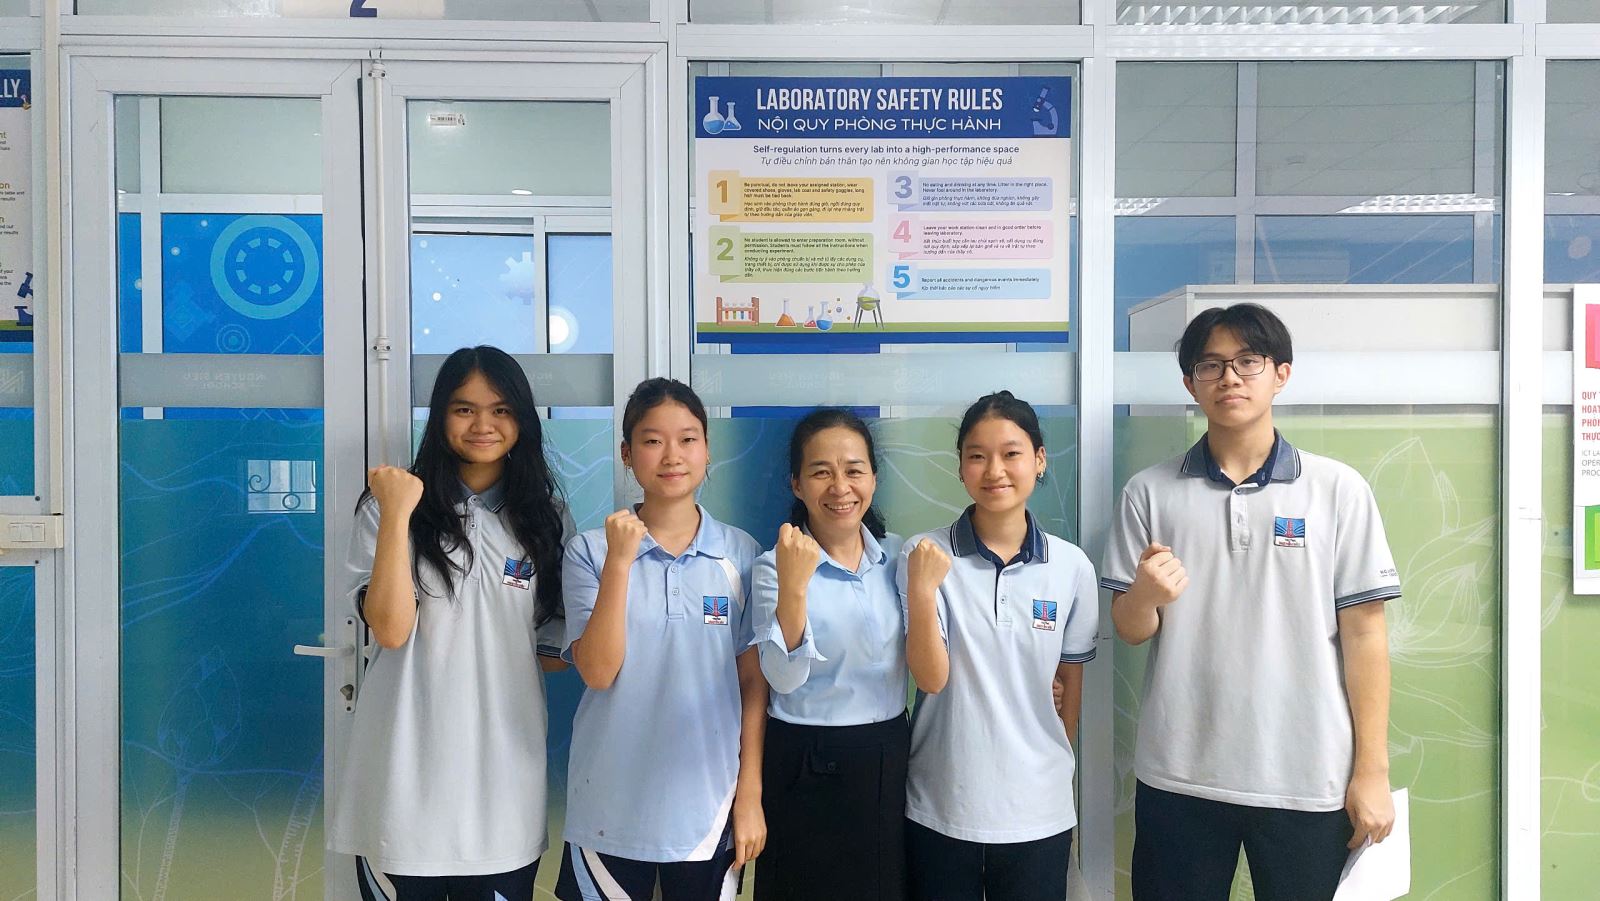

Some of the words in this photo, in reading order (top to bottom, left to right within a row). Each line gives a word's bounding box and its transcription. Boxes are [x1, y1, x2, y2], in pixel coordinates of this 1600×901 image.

[0, 78, 21, 98] LY
[757, 88, 872, 111] LABORATORY
[876, 88, 943, 111] SAFETY
[948, 88, 1003, 111] RULES
[758, 115, 788, 133] NỘI
[793, 118, 829, 131] QUY
[834, 115, 897, 131] PHÒNG
[901, 116, 947, 134] THỰC
[951, 115, 1001, 131] HÀNH
[753, 145, 818, 155] Self-regulation
[819, 145, 843, 153] turns
[844, 146, 869, 155] every
[871, 145, 884, 153] lab
[886, 145, 903, 153] into
[912, 145, 991, 155] high-performance
[993, 147, 1020, 155] space
[716, 180, 728, 204] 1
[894, 175, 913, 199] 3
[892, 220, 912, 243] 4
[716, 237, 735, 261] 2
[893, 265, 911, 289] 5
[1581, 391, 1597, 400] QUY
